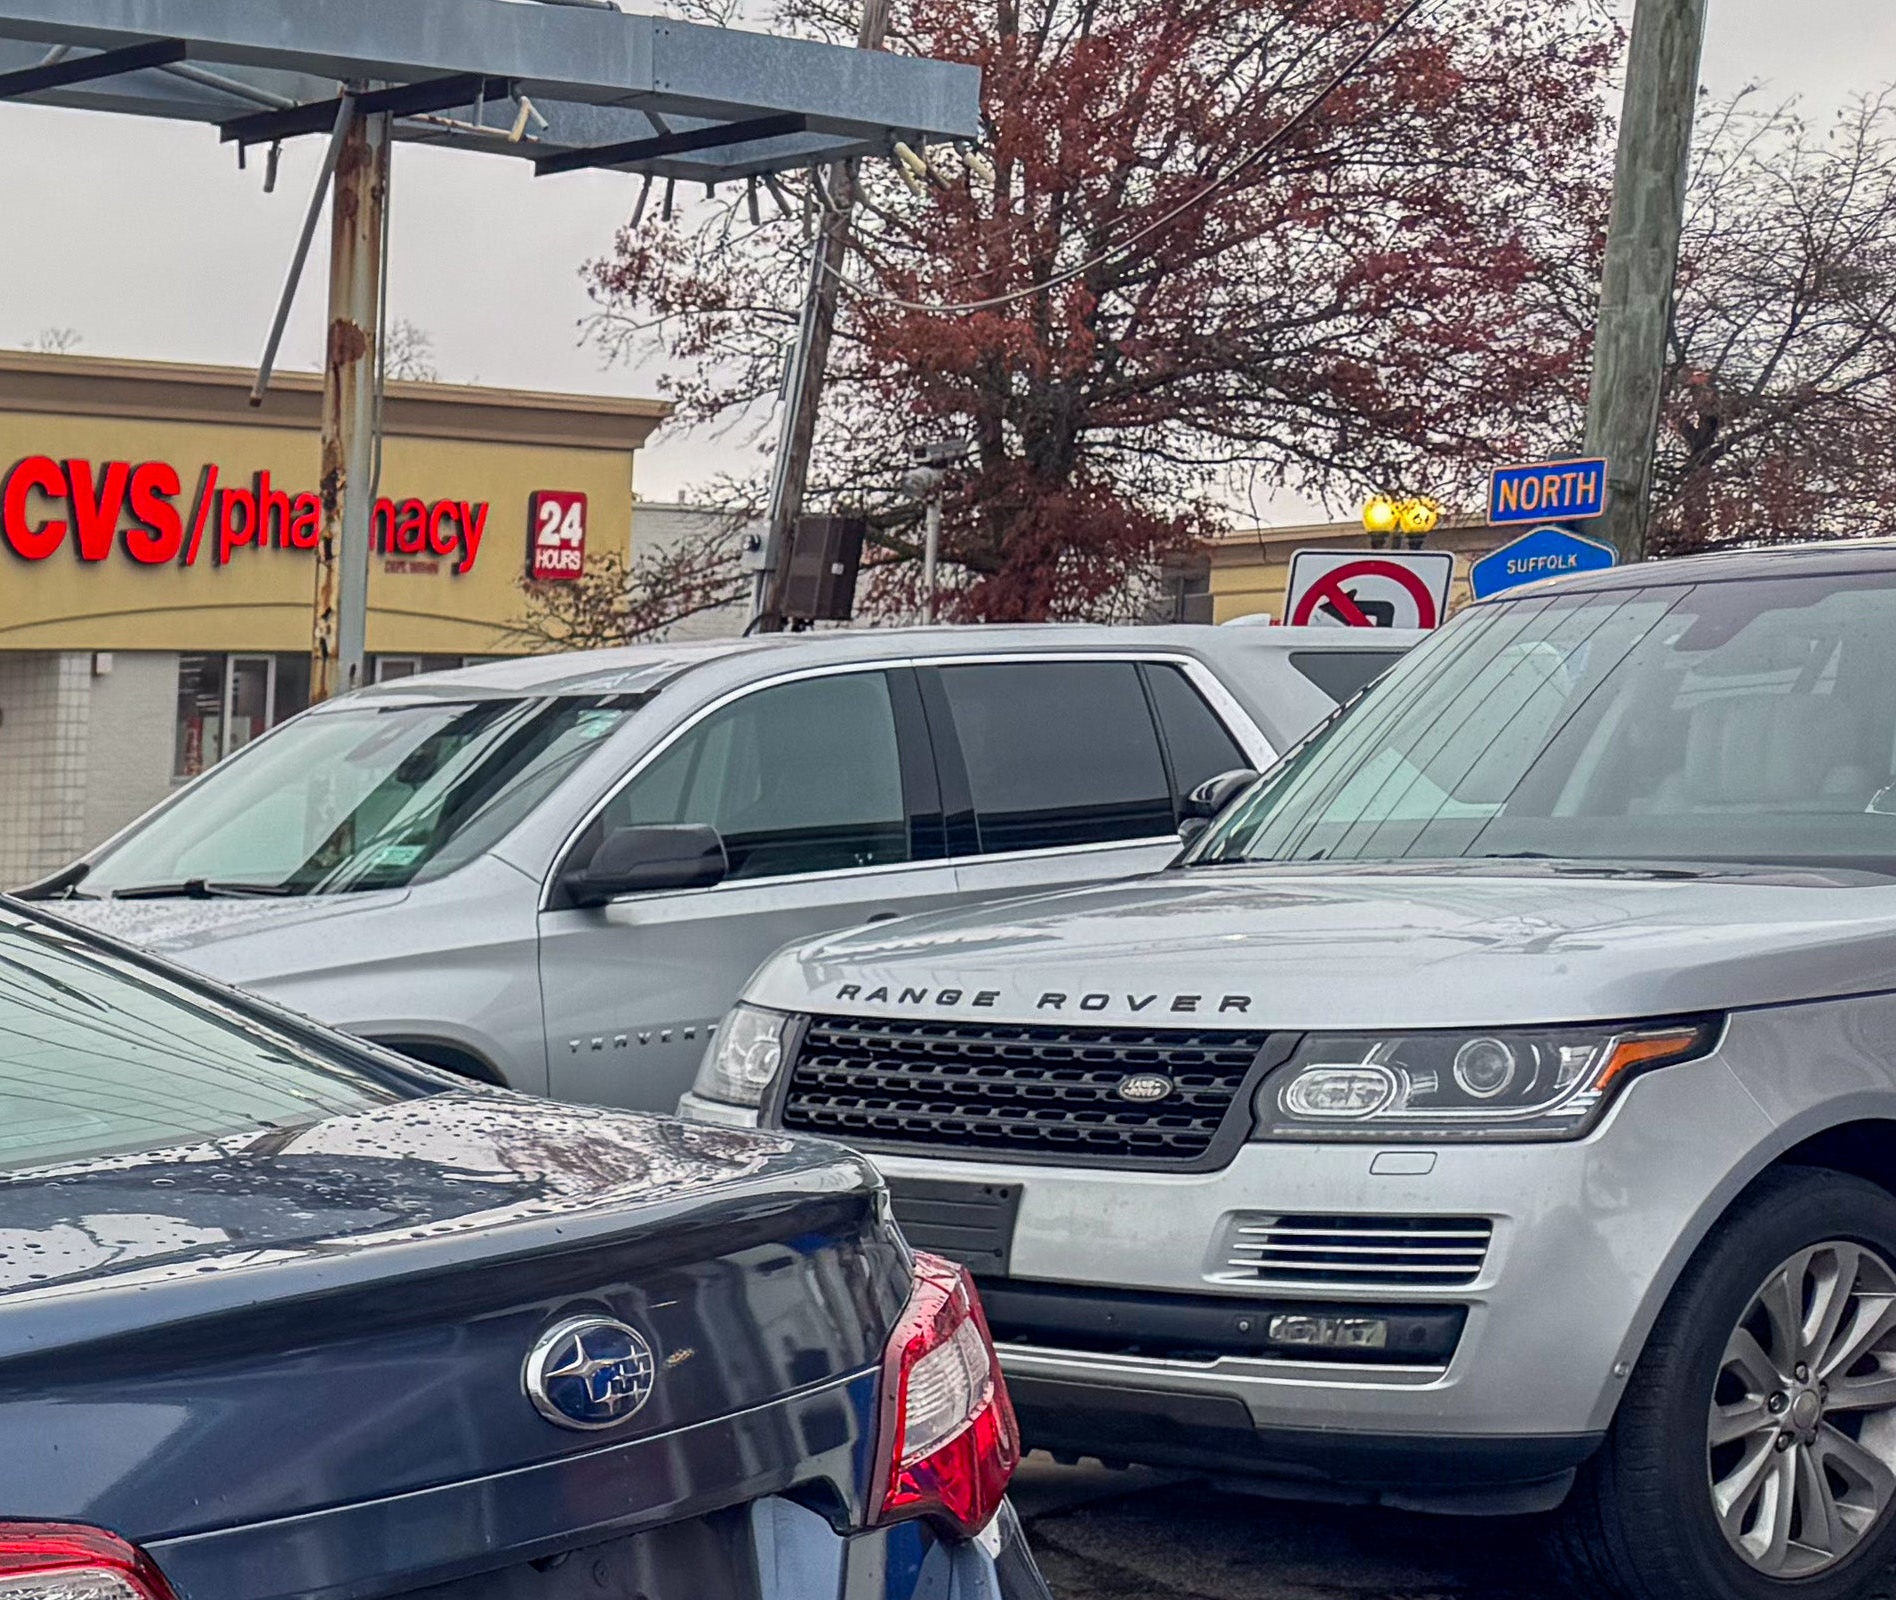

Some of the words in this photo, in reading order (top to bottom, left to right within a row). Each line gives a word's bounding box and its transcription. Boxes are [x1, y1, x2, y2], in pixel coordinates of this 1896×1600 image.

[1498, 471, 1597, 513] NORTH
[2, 454, 489, 574] CVS/phamacy
[537, 500, 583, 548] 24
[535, 548, 582, 571] HOURS
[1506, 553, 1578, 575] SUFFOLK
[835, 984, 1001, 1008] RANGE
[1036, 991, 1253, 1013] ROVER
